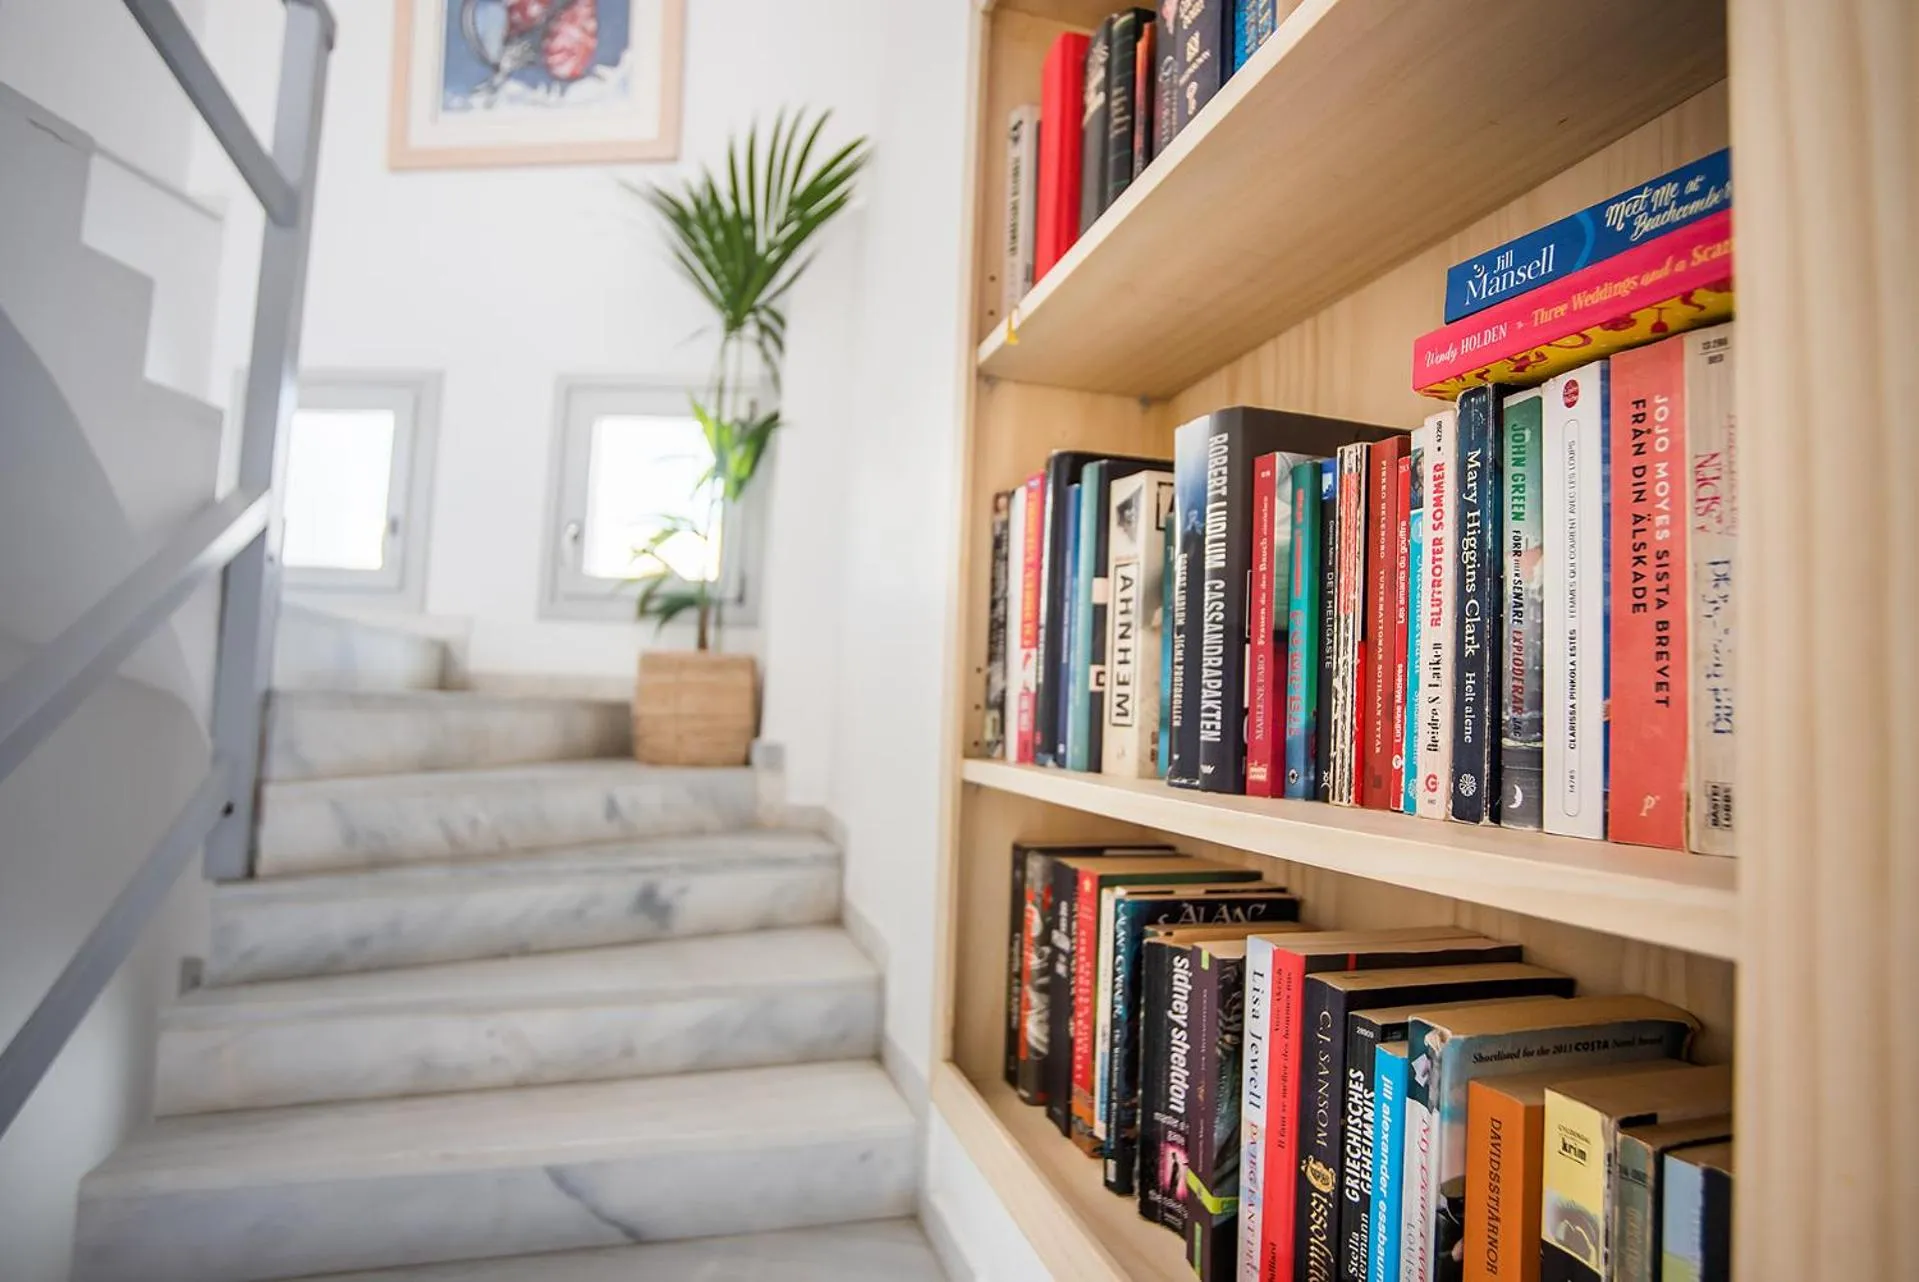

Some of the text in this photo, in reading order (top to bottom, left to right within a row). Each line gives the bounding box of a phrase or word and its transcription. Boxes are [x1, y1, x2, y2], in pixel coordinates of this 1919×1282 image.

[1605, 186, 1651, 232] Meet
[1651, 182, 1679, 212] Me
[1684, 175, 1706, 195] at
[1464, 245, 1555, 306] Mansell
[1493, 250, 1513, 274] Jill
[1425, 346, 1458, 368] Wendy
[1460, 321, 1508, 355] HOLDEN
[1532, 303, 1568, 327] Three
[1571, 274, 1639, 313] Weddings
[1640, 264, 1672, 287] and
[1674, 260, 1686, 272] a
[1511, 423, 1526, 469] JOHN
[1568, 439, 1576, 471] LOUPS
[1432, 462, 1446, 531] SOMMER
[1462, 448, 1481, 505] Mary
[1511, 473, 1526, 522] GREEN
[1632, 398, 1652, 614] FRÅN DIN ÄLSKADE
[1259, 537, 1268, 572] Bauch
[1400, 520, 1408, 555] gouffre
[1461, 510, 1481, 594] Higgins
[1653, 394, 1670, 709] JOJO MOYES SISTA BREVET
[1200, 432, 1229, 743] ROBERT LUDLUM CASSANDRAPAKTEN
[1326, 572, 1334, 595] DET
[1400, 556, 1406, 570] du
[1430, 536, 1445, 628] BLUTROTER
[1174, 589, 1187, 626] LUDLUM
[1398, 607, 1406, 625] Les
[1511, 577, 1524, 625] SENARE
[1115, 574, 1134, 719] AHNHEM
[1174, 632, 1186, 661] SIGMA
[1257, 607, 1267, 646] Frauen
[1325, 600, 1334, 669] HELIGASTE
[1464, 599, 1481, 658] Clark
[1257, 653, 1265, 682] FARO
[1428, 642, 1443, 688] Laiken
[1464, 671, 1476, 702] Helt
[1511, 630, 1525, 717] EXPLODERAR
[1569, 659, 1577, 701] PINKOLA
[1254, 683, 1266, 740] MARLENE
[1464, 704, 1474, 744] alene
[1569, 703, 1577, 750] CLARISSA
[1116, 903, 1128, 952] ALAN
[1168, 955, 1192, 1017] sidney
[1247, 970, 1265, 1111] Lisa Jewell
[1472, 1047, 1520, 1064] Shortlisted
[1521, 1046, 1535, 1059] for
[1535, 1045, 1551, 1057] the
[1552, 1043, 1573, 1055] 2011
[1574, 1039, 1610, 1052] COSTA
[1168, 1018, 1190, 1114] sheldon
[1315, 1010, 1333, 1149] C.J. SANSOM
[1380, 1074, 1394, 1101] jill
[1345, 1068, 1365, 1203] GRIECHISCHES
[1360, 1088, 1375, 1196] GEHEIMNIS
[1378, 1103, 1393, 1198] alexander
[1561, 1137, 1587, 1161] krim
[1347, 1230, 1361, 1275] Stella
